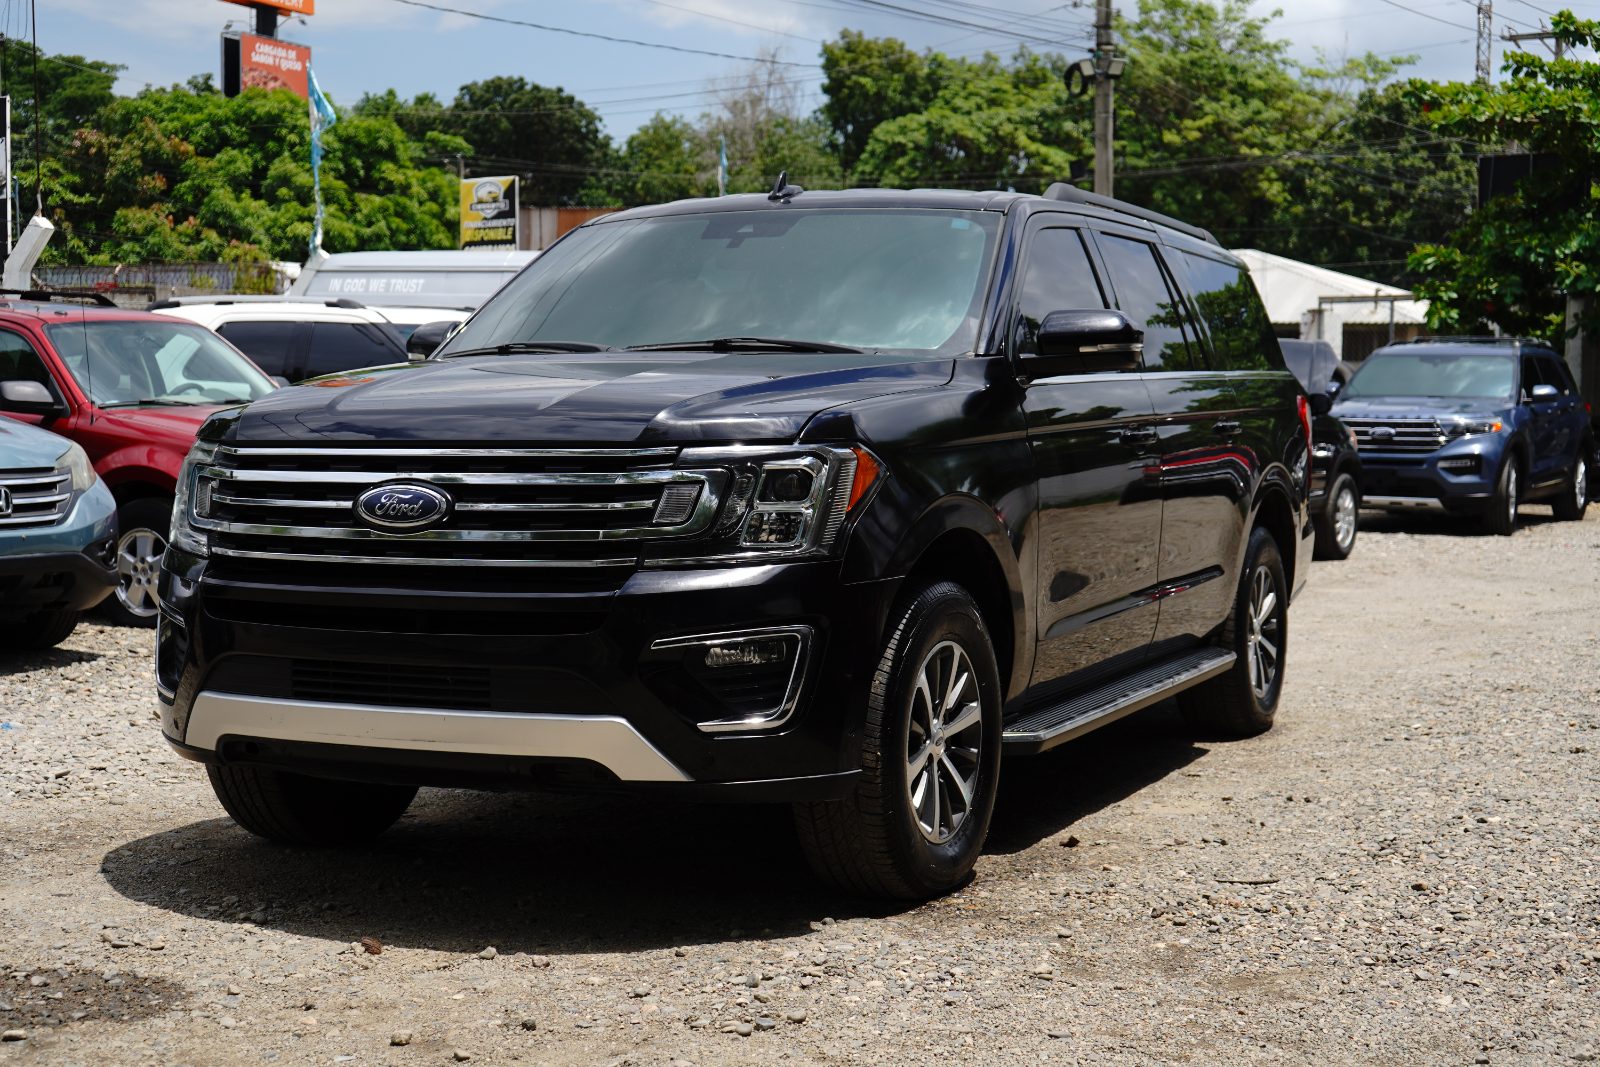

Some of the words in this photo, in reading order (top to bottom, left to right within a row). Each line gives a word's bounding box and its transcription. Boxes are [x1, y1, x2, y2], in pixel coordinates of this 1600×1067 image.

[328, 278, 342, 292] IN
[343, 278, 366, 292] GOD
[368, 278, 387, 292] WE
[389, 278, 425, 292] TRUST
[375, 493, 423, 516] Ford
